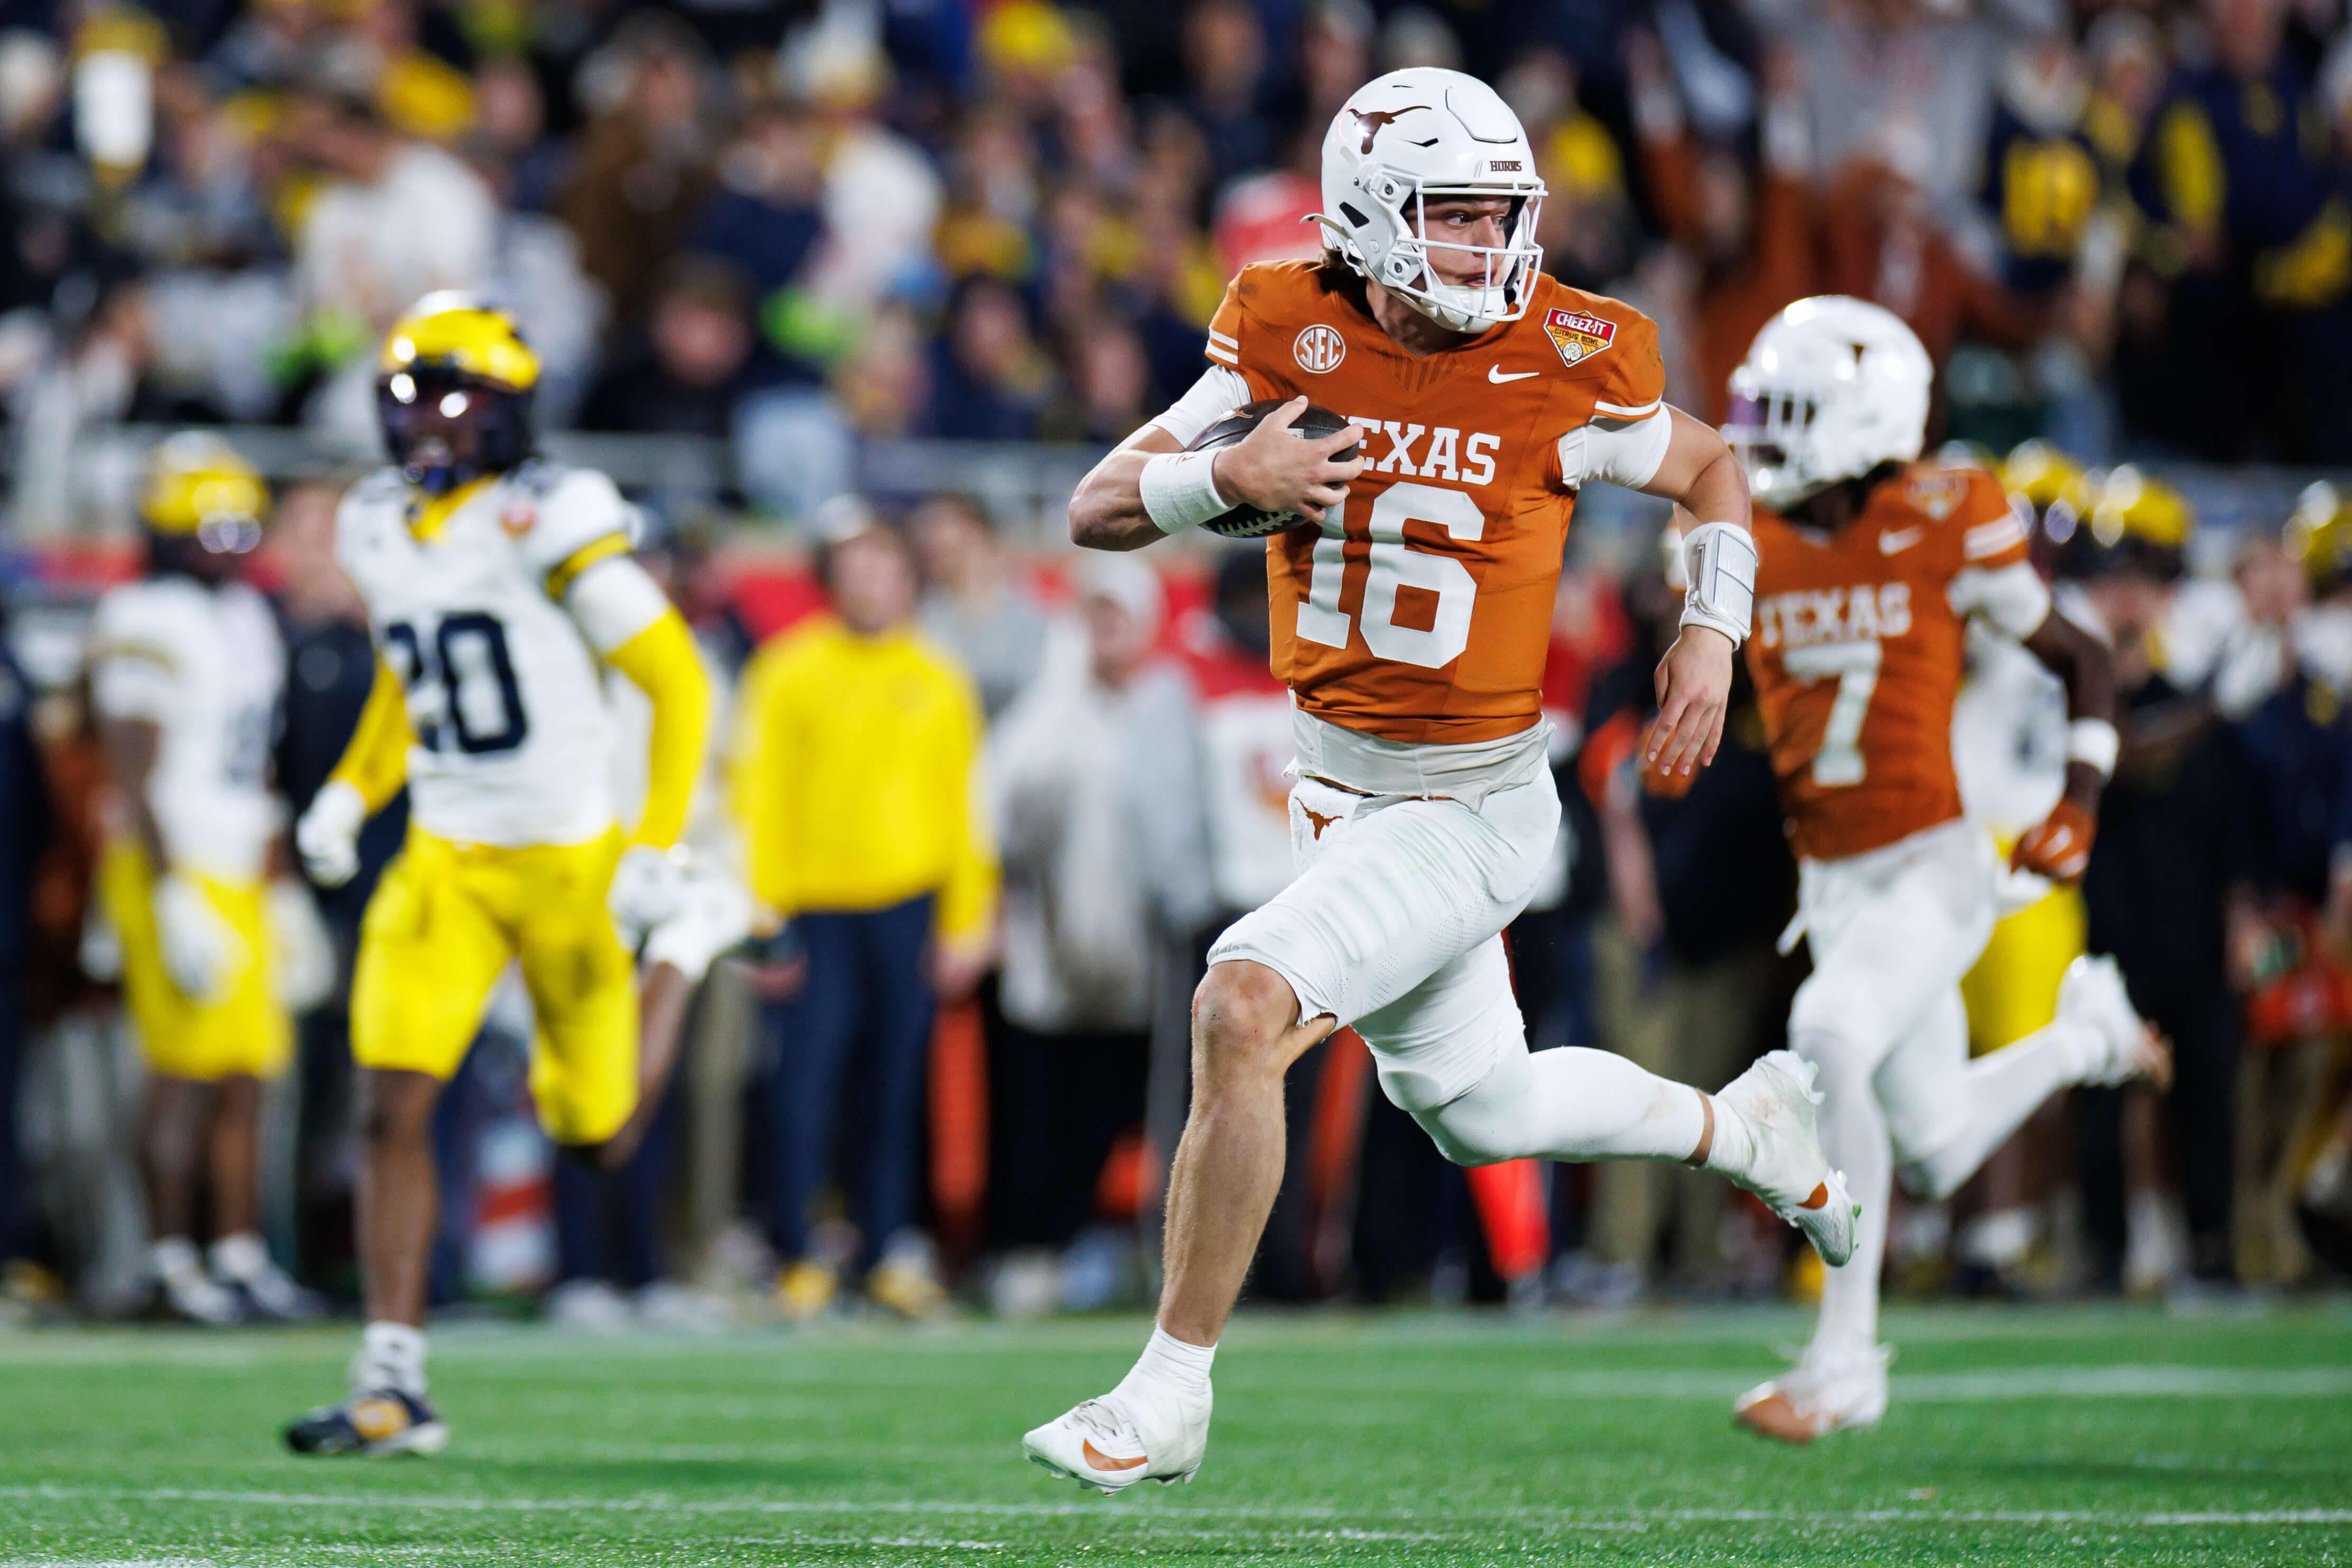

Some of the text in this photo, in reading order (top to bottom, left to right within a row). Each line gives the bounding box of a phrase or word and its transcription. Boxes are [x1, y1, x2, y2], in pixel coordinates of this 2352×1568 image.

[1490, 161, 1522, 172] HORNS
[1300, 328, 1340, 370] SEC
[1555, 329, 1599, 346] CITRUS BOWL
[1340, 415, 1501, 486] EXAS
[1296, 481, 1485, 669] 16
[1758, 583, 1911, 647] TEXAS
[1784, 640, 1882, 786] 7
